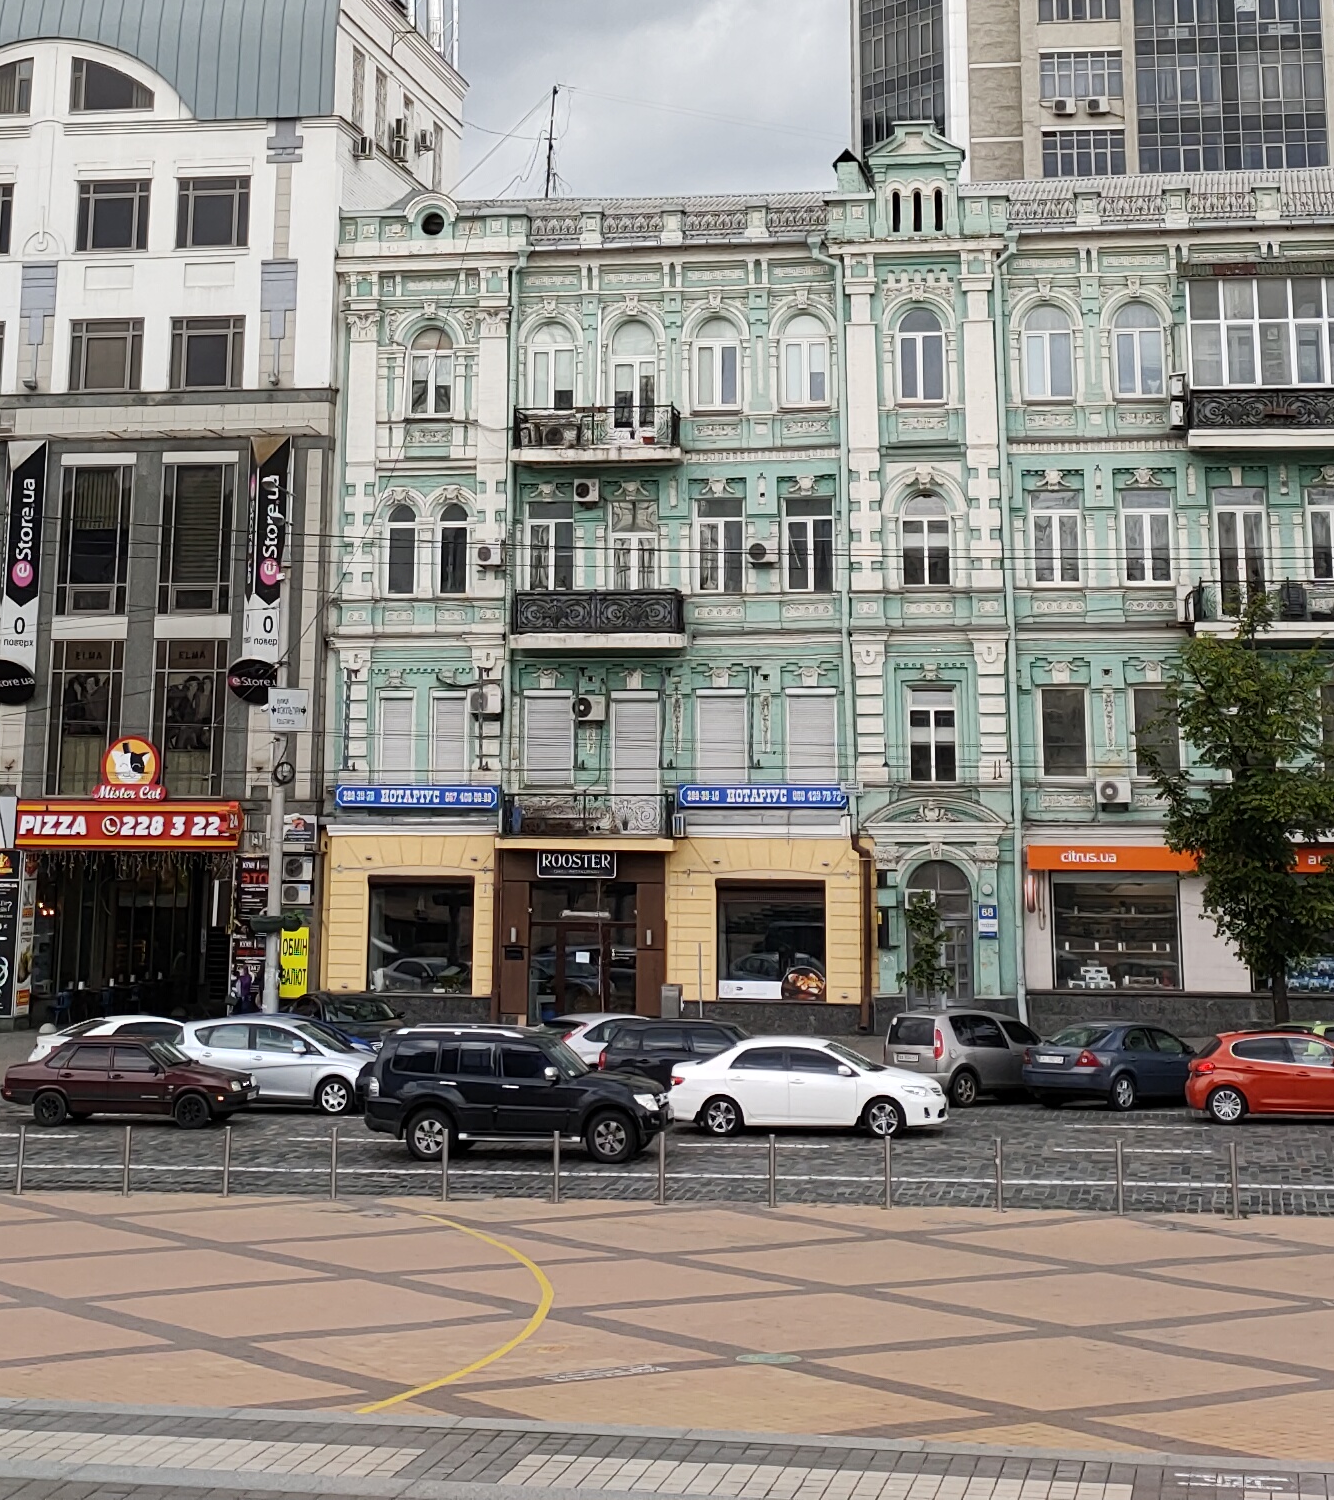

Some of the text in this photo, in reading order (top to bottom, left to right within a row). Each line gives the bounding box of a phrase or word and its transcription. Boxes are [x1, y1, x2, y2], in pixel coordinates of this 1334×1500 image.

[14, 477, 36, 581] eStore.ua
[14, 617, 25, 635] 0
[254, 638, 278, 647] повер
[94, 785, 162, 800] Mister Cat
[19, 815, 230, 836] PIZZA 228 3 22
[542, 853, 611, 869] ROOSTER
[1060, 850, 1117, 863] citrus.ua
[283, 938, 308, 956] ОБМІН
